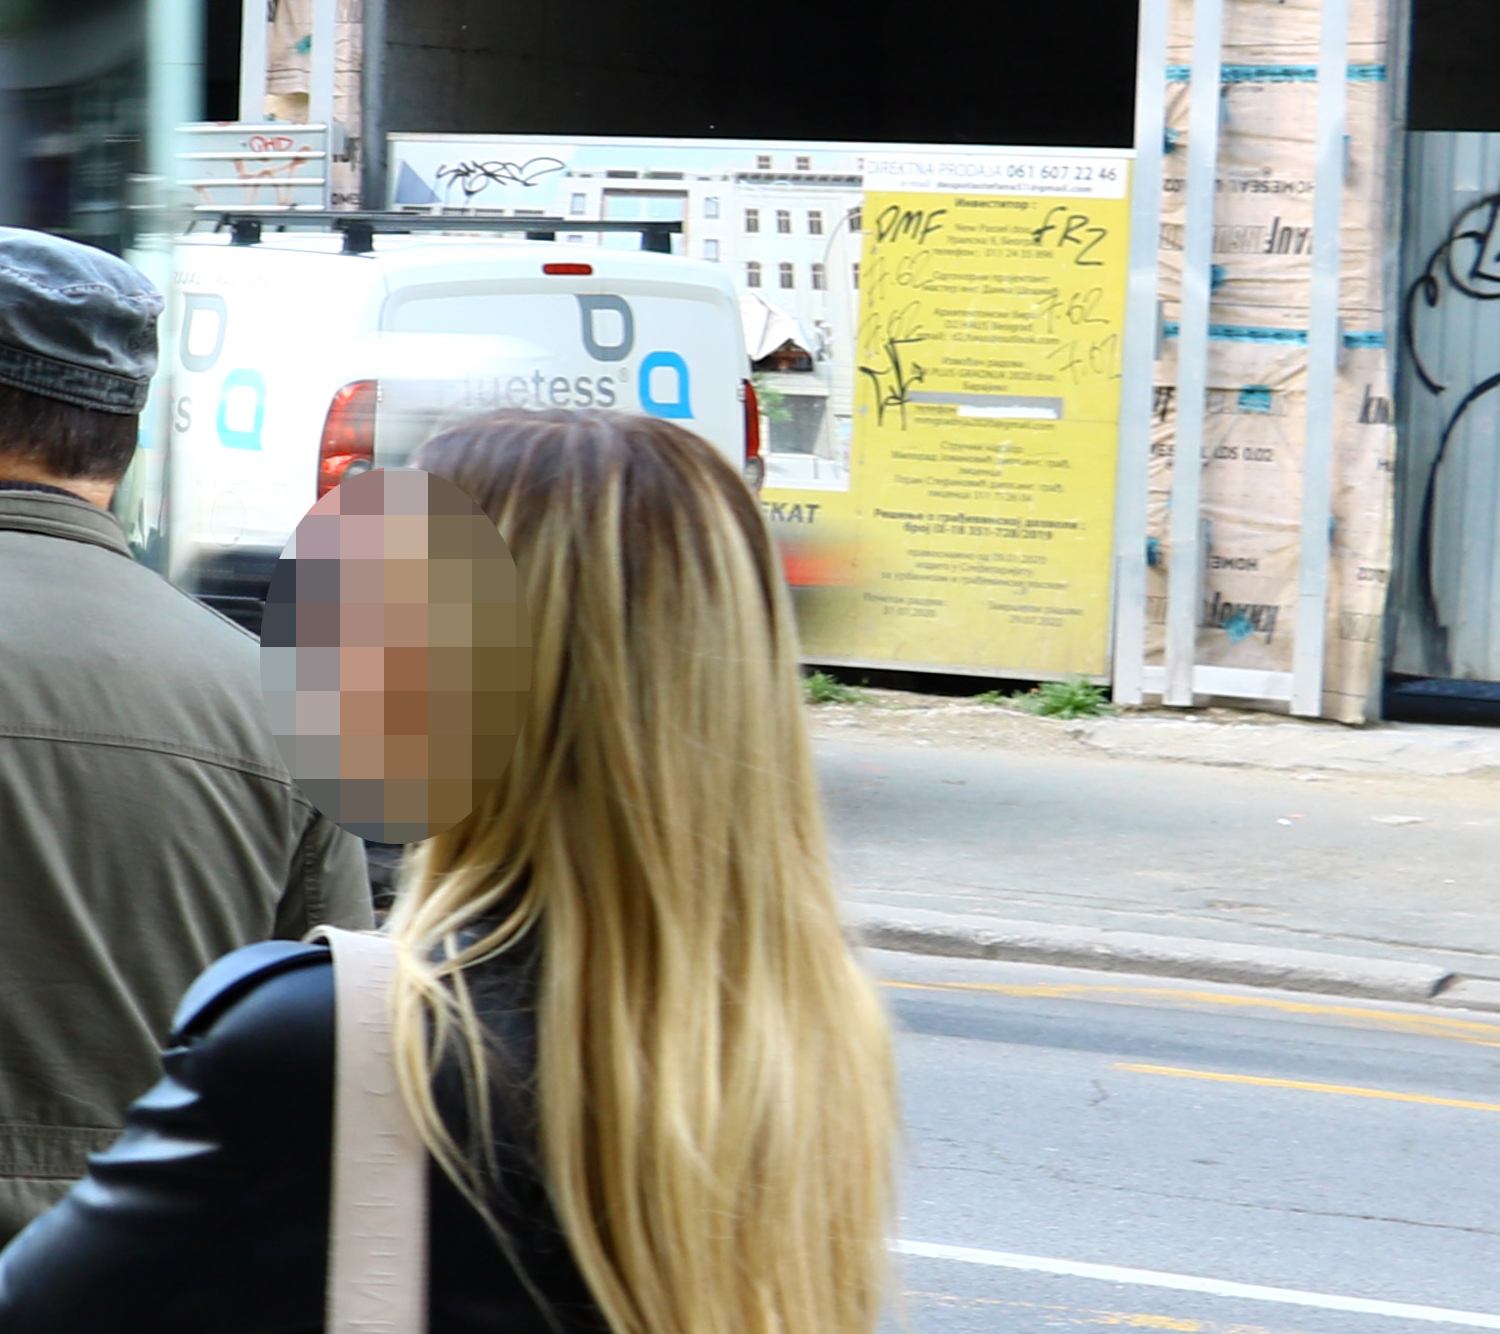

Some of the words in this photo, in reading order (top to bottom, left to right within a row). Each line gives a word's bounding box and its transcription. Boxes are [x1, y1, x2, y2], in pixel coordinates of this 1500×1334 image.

[866, 160, 934, 175] DIREKTNA
[938, 163, 1001, 177] PRODAJA
[1006, 164, 1035, 179] 061
[1040, 165, 1070, 180] 607
[1074, 166, 1093, 181] 22
[1098, 167, 1118, 182] 46
